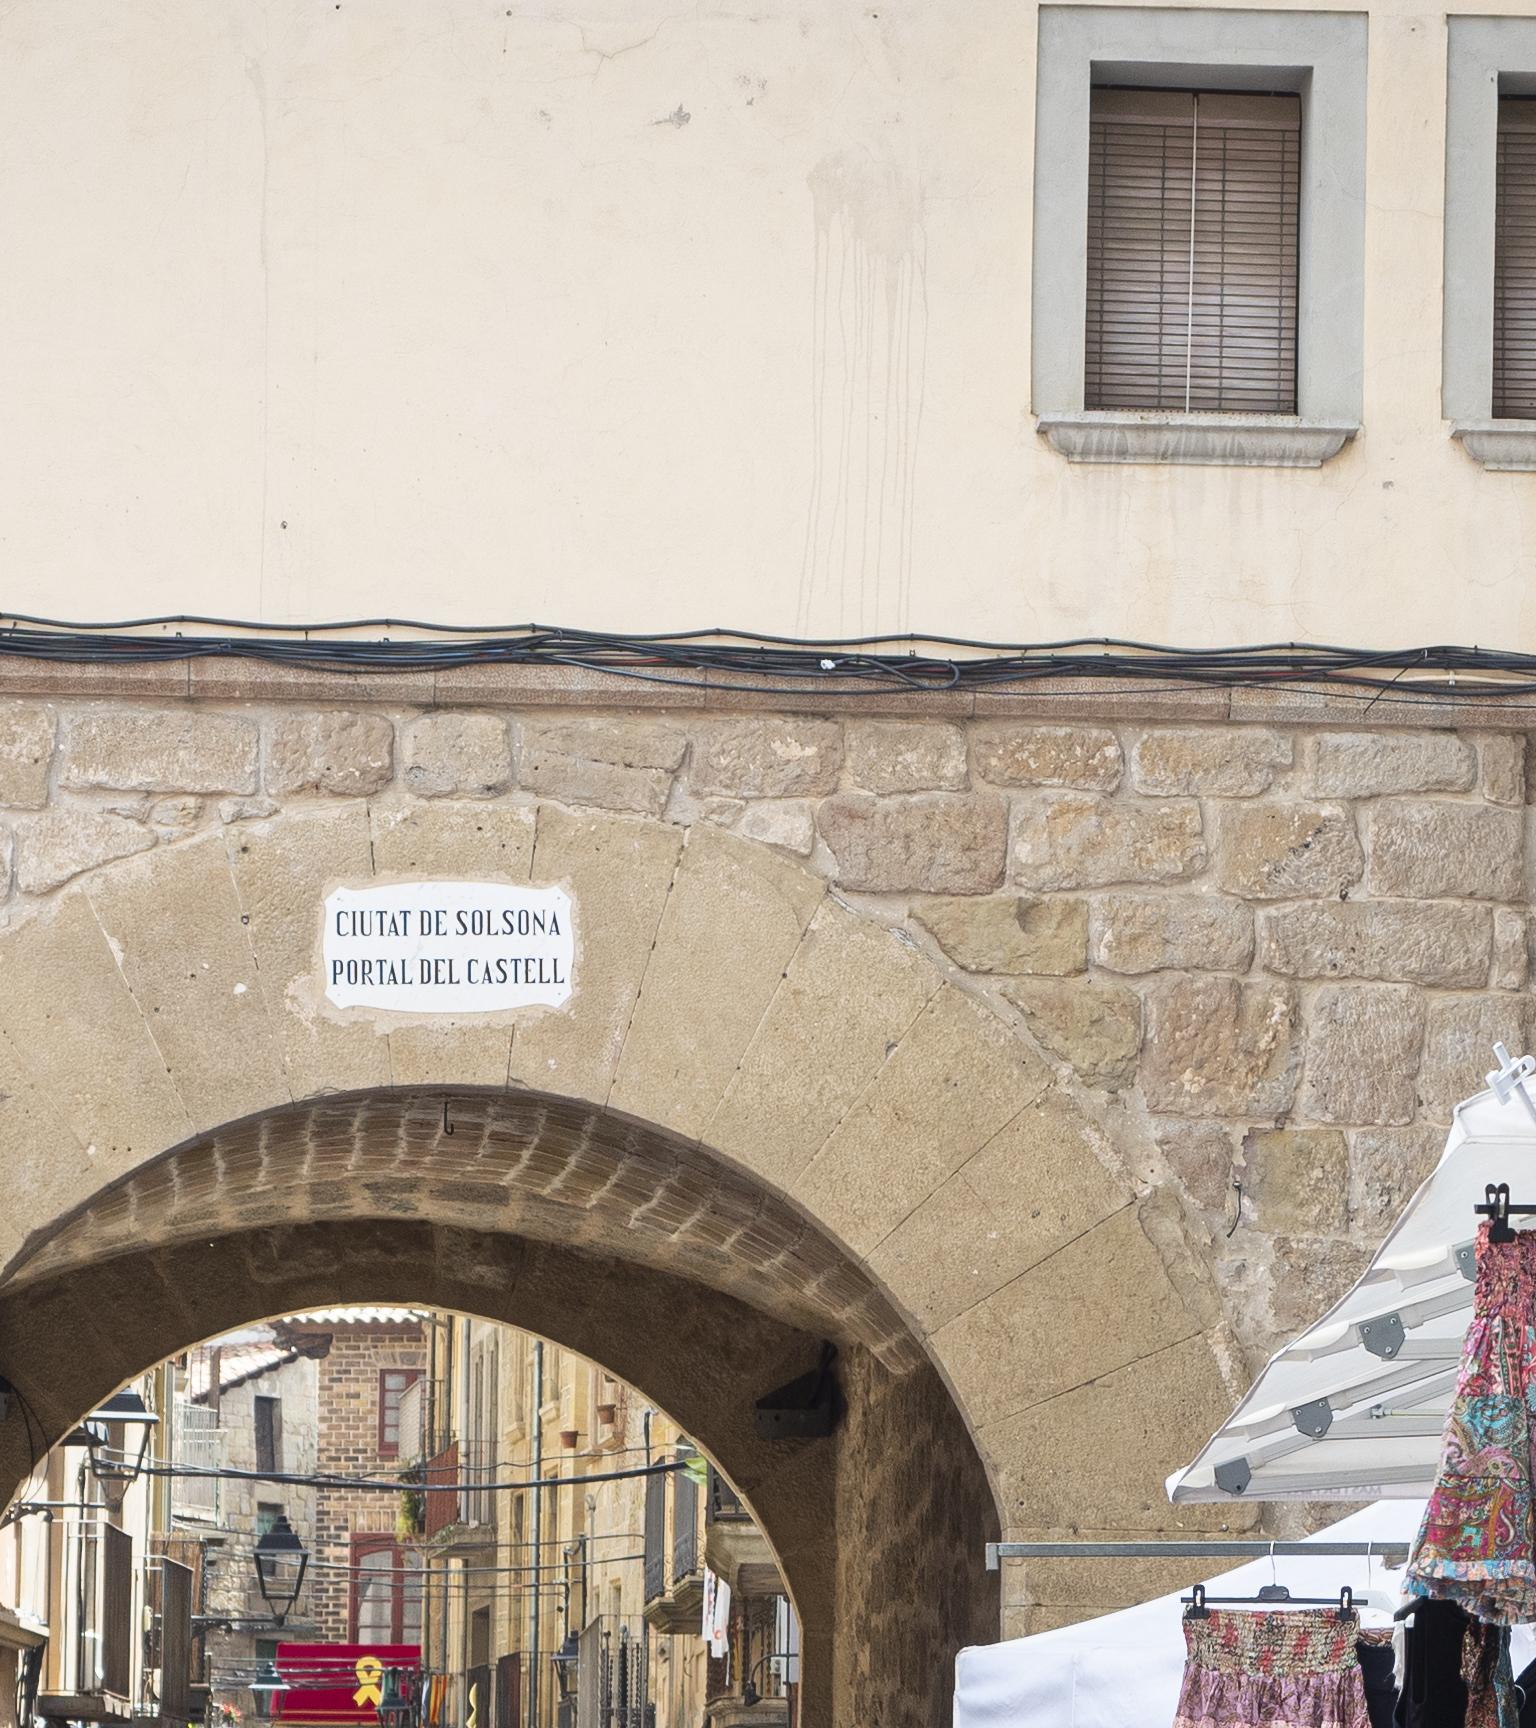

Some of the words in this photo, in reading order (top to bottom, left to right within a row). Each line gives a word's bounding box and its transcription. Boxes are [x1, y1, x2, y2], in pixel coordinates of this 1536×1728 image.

[335, 910, 412, 937] CIUTAT
[419, 910, 448, 937] DE
[454, 909, 562, 936] SOLSONA
[331, 958, 413, 986] PORTAL
[419, 958, 460, 986] DEL
[466, 957, 566, 985] CASTELL
